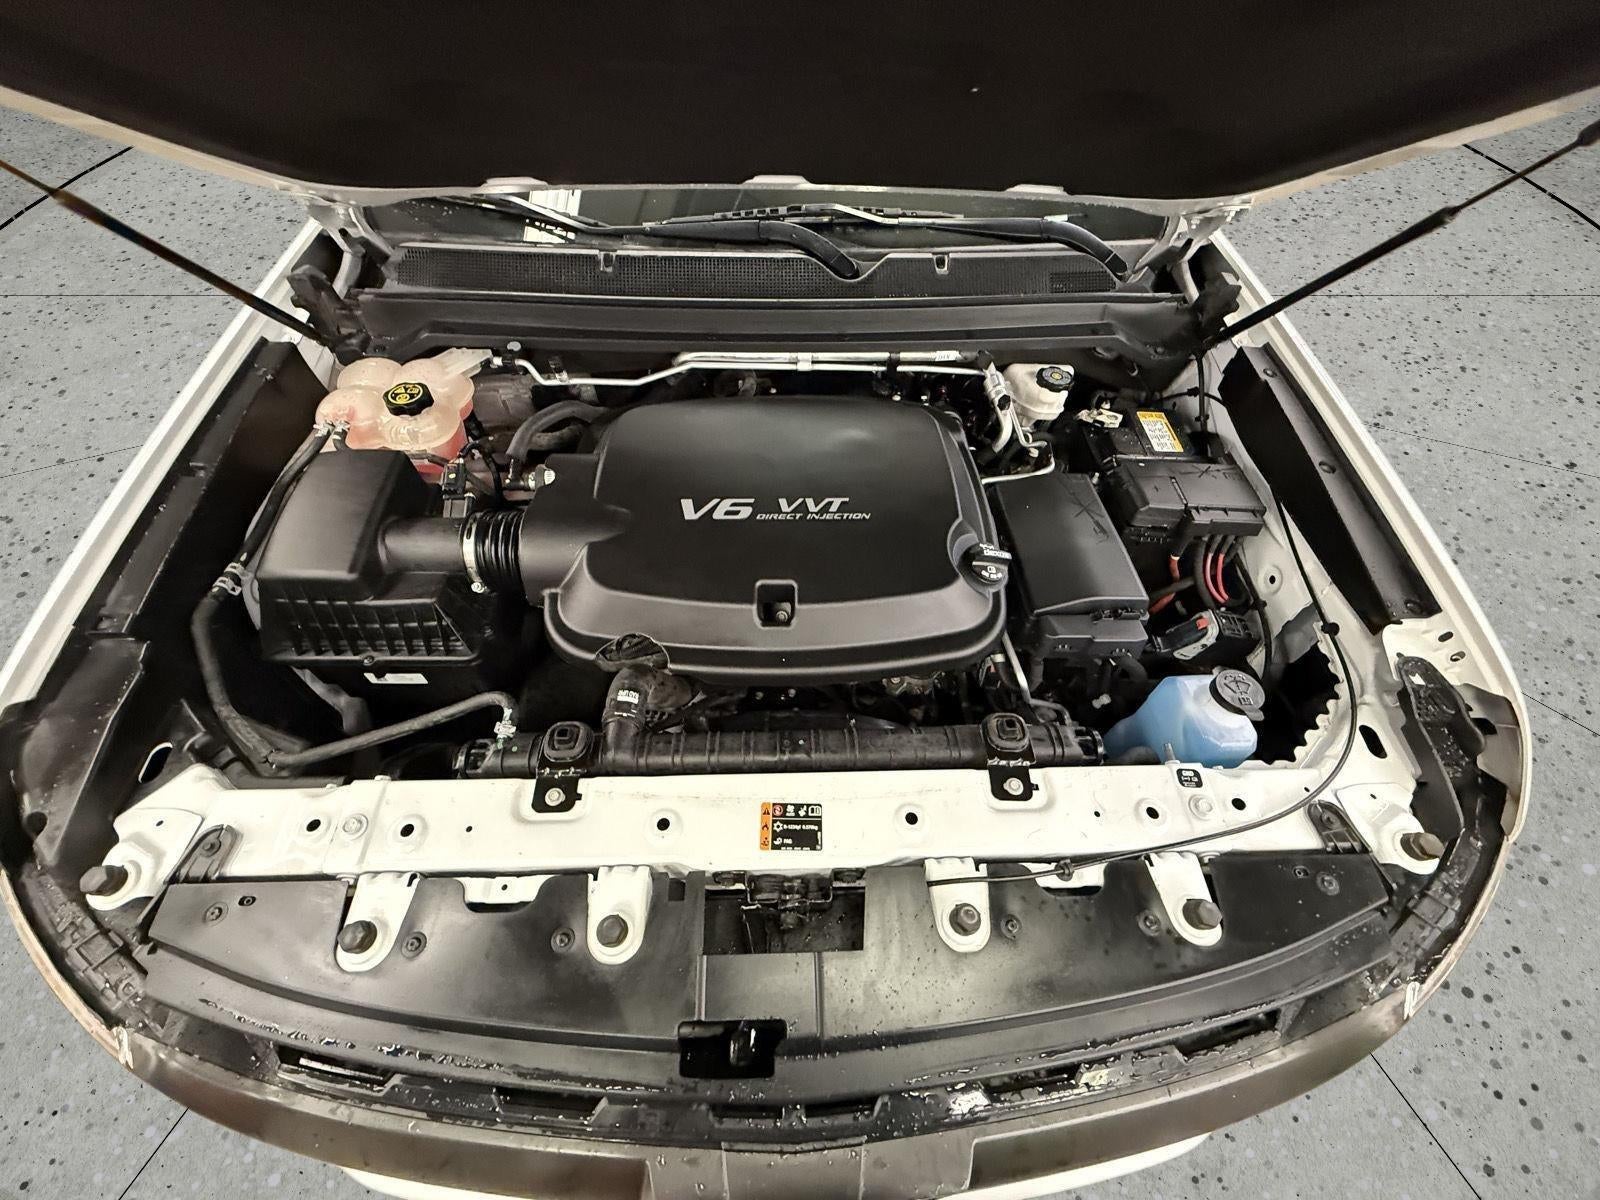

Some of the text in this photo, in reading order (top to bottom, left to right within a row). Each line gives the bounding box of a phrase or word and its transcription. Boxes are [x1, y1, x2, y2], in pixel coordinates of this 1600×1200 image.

[680, 497, 849, 521] V6 VVT
[756, 512, 872, 520] DIRECT INJECTION
